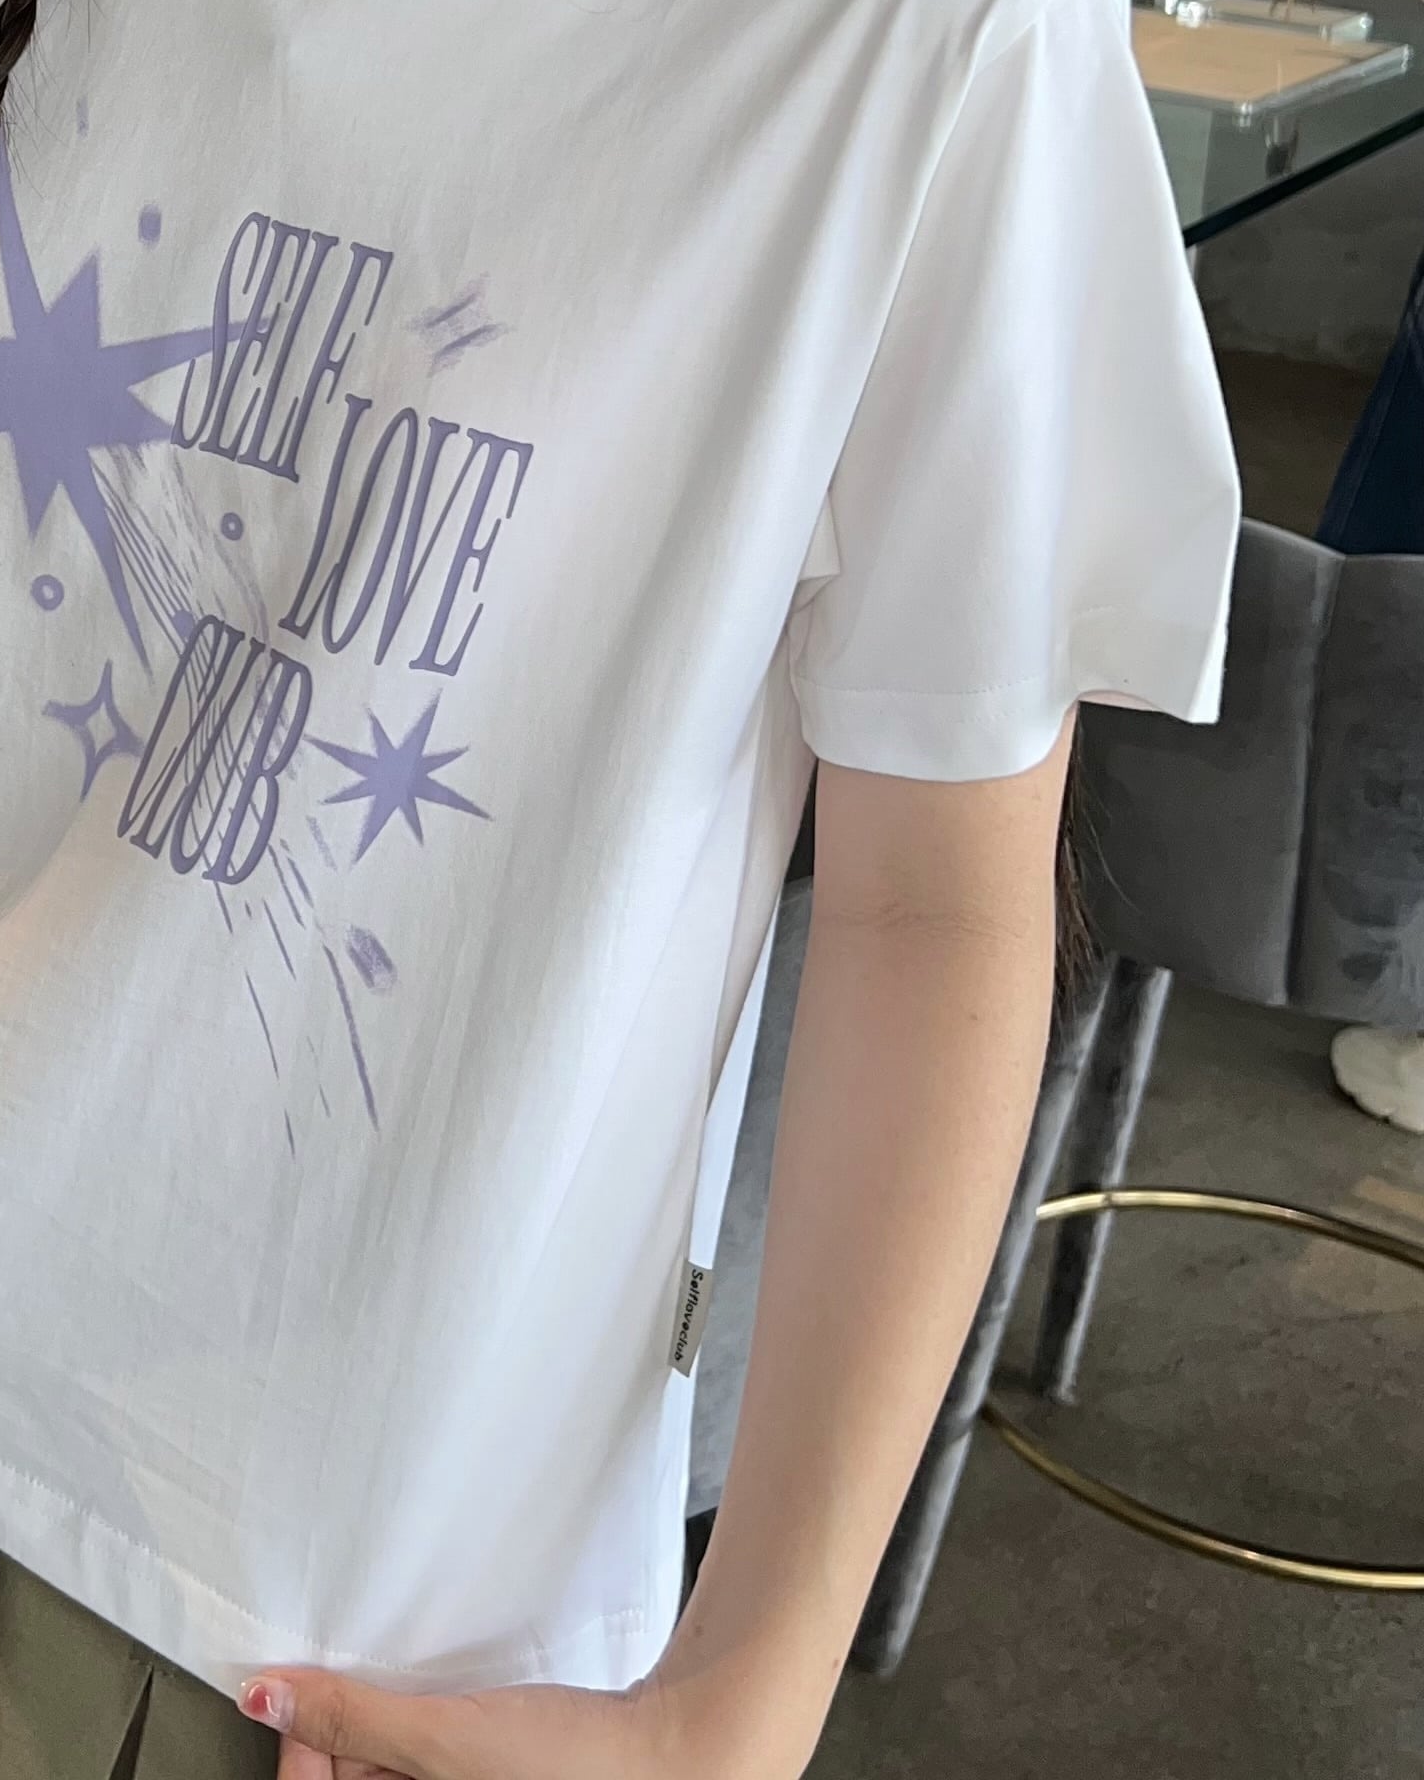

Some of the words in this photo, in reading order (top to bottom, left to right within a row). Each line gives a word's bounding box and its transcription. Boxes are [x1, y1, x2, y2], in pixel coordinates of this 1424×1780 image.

[172, 211, 395, 483] SELF
[278, 393, 533, 677] LOVE
[117, 614, 313, 885] CLUB
[673, 1269, 704, 1362] Selfloveclub
